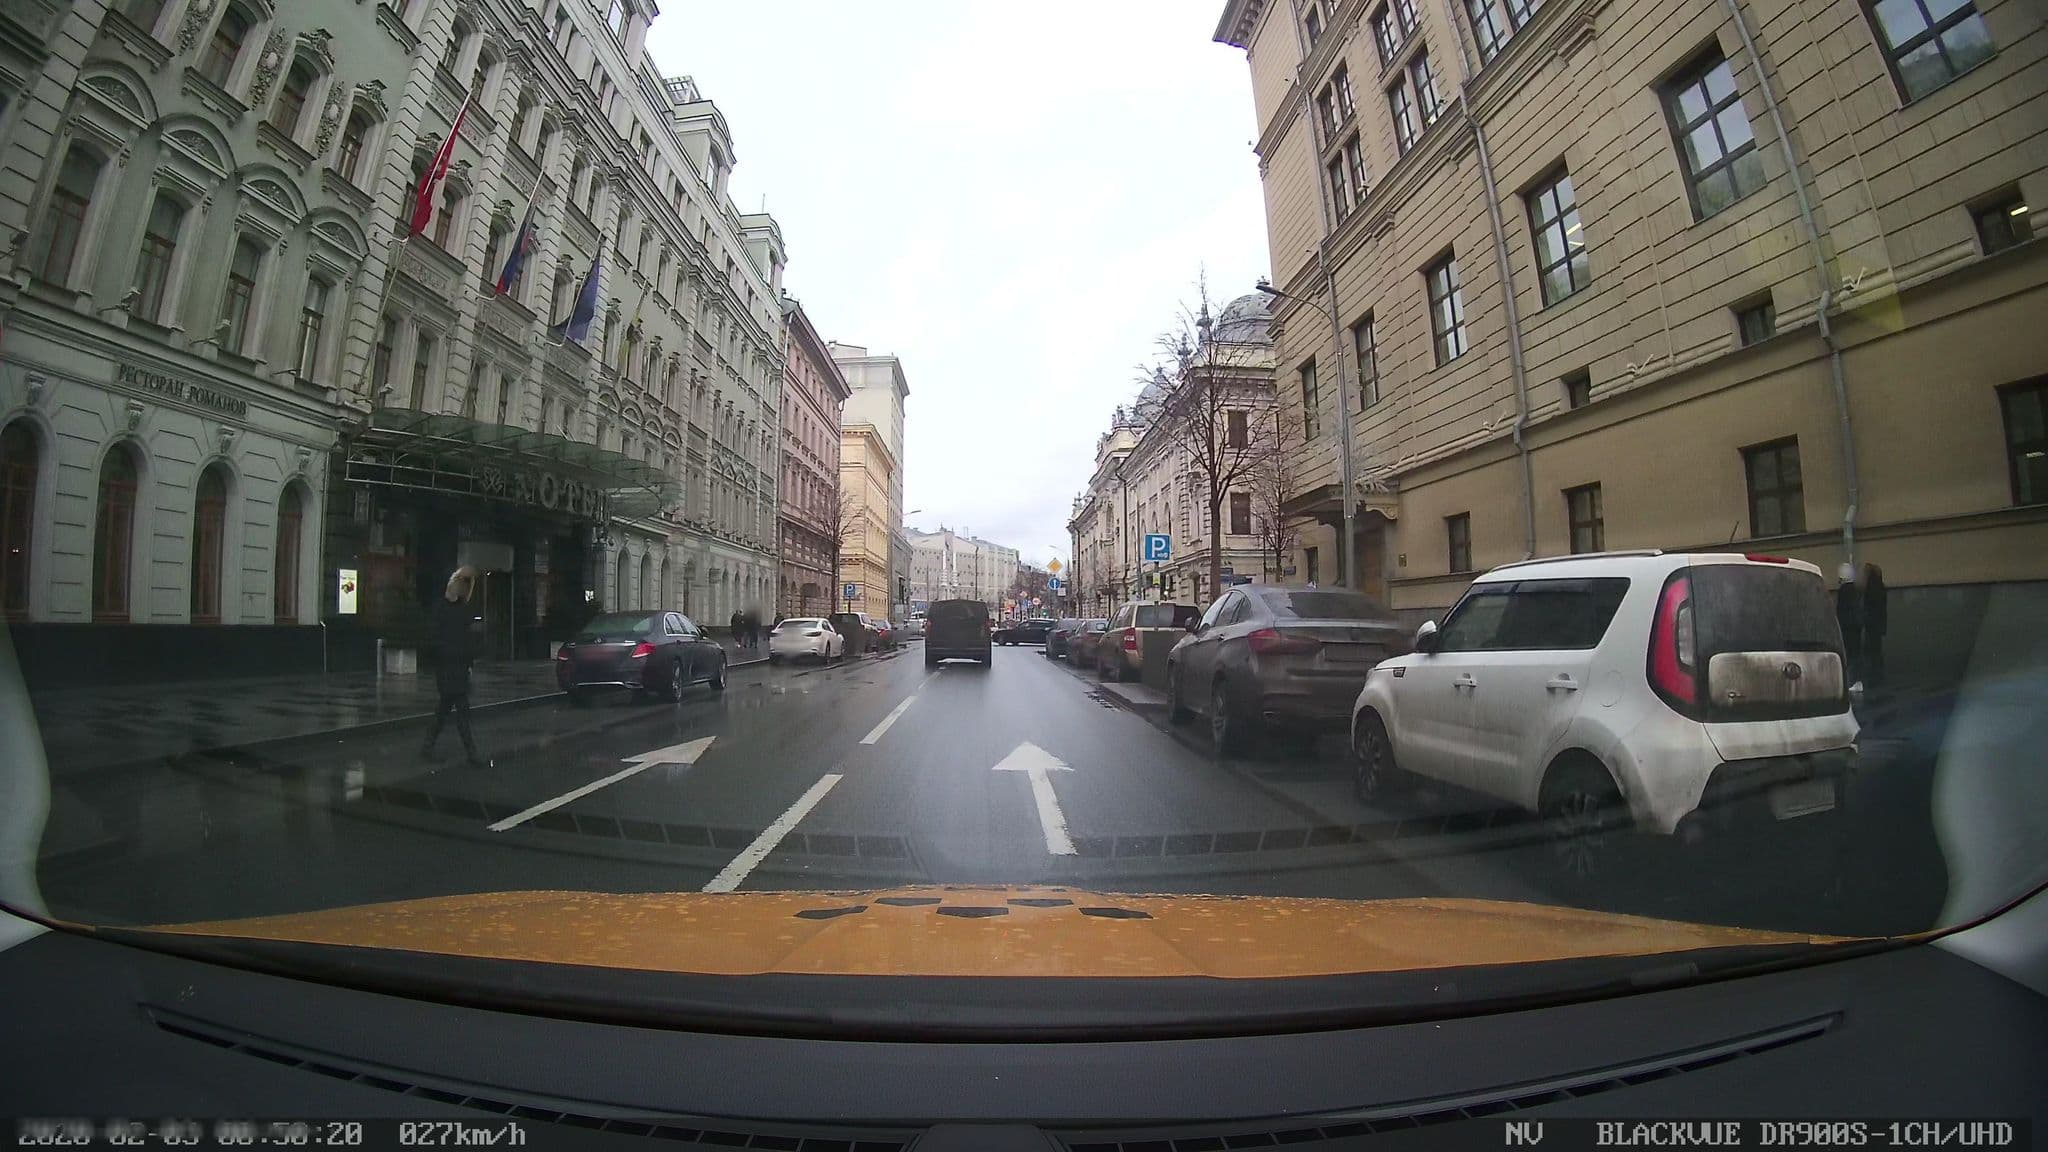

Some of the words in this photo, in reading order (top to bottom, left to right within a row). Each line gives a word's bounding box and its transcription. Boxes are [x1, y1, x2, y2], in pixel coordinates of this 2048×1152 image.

[118, 363, 184, 397] РЕСТОРАН
[189, 385, 247, 416] РОМАНОВ
[1152, 537, 1166, 558] P
